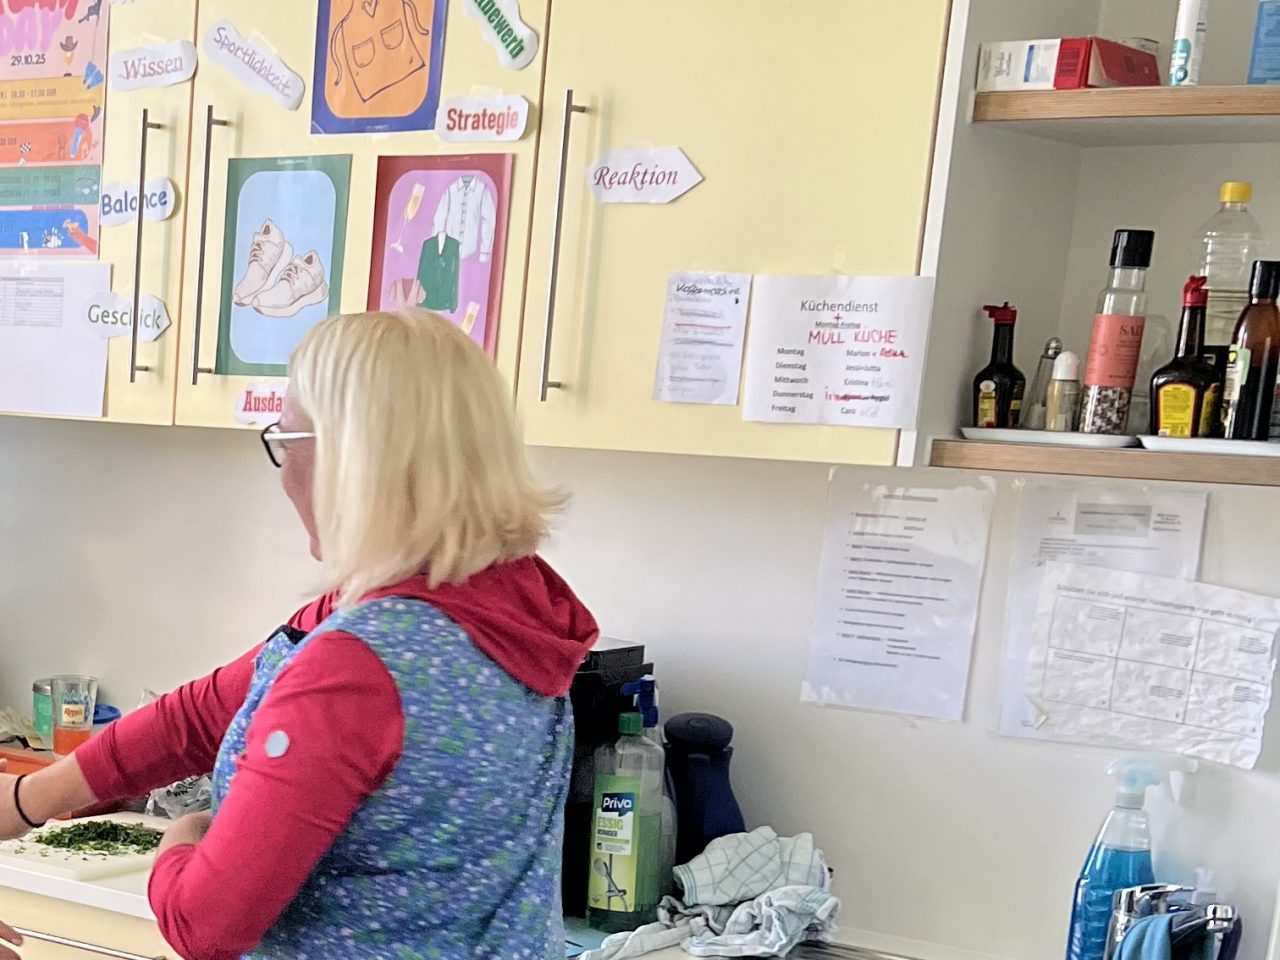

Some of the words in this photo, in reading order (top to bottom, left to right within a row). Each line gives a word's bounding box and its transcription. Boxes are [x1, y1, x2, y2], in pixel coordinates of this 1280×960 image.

[10, 53, 46, 66] 29.10.25
[214, 27, 290, 97] Sportlichkeit
[118, 56, 183, 80] Wissen
[446, 105, 519, 135] Strategie
[593, 162, 678, 191] Reaktion
[800, 300, 879, 313] Küchendienst
[808, 329, 845, 345] MÜLL
[854, 327, 897, 343] KÜCHE
[777, 347, 805, 357] Montag
[776, 362, 807, 371] Dienstag
[774, 376, 809, 384] Mittwoch
[844, 378, 869, 386] Cristina
[242, 391, 284, 412] Ausda
[773, 390, 813, 400] Donnerstag
[771, 404, 796, 413] Freitag
[603, 796, 632, 809] Priva
[597, 817, 623, 830] ESSIG
